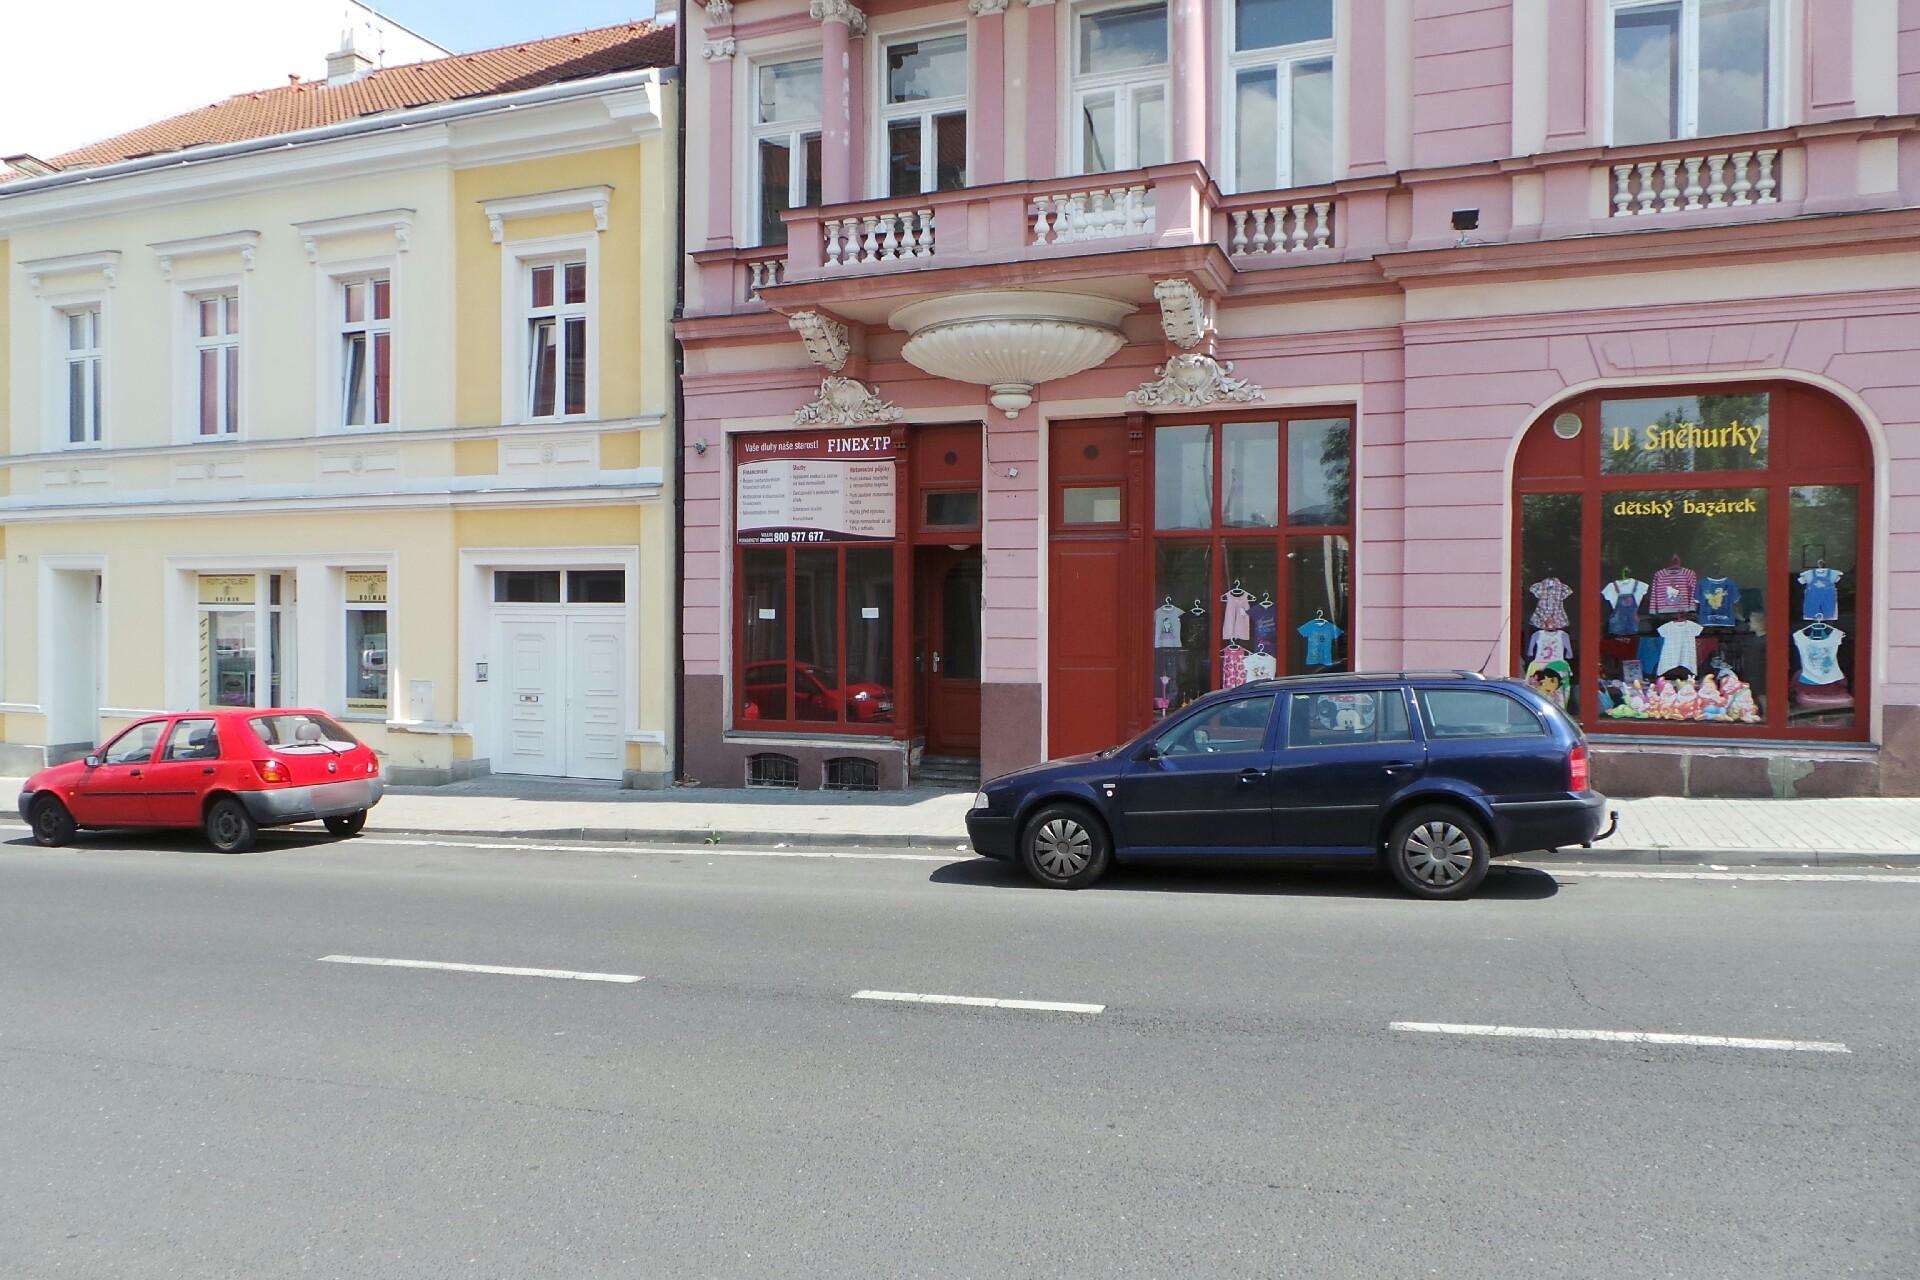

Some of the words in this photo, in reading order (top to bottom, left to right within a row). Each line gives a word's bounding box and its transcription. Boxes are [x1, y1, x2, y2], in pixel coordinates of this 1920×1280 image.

[827, 436, 891, 453] FINEX-TP
[1613, 427, 1631, 451] U
[1643, 420, 1762, 455] Sněhurky
[744, 442, 760, 452] Vaše
[760, 442, 777, 453] dluhy
[778, 441, 793, 451] naše
[1614, 500, 1674, 518] dětský
[1683, 498, 1757, 517] bazárek
[773, 532, 789, 543] 800
[791, 531, 806, 542] 577
[808, 531, 824, 542] 677
